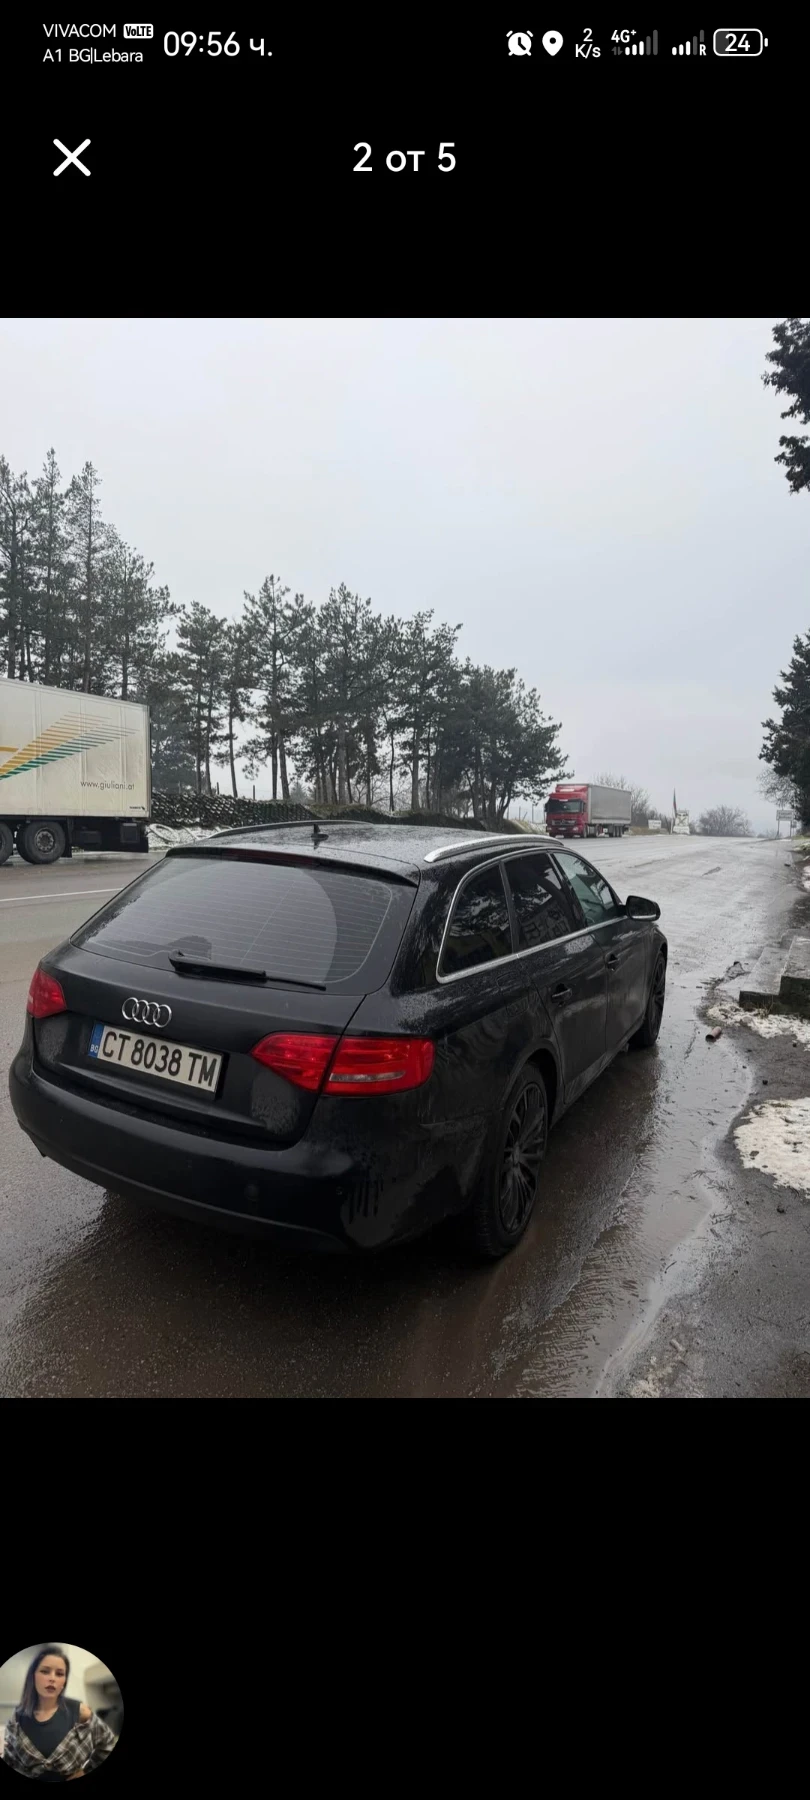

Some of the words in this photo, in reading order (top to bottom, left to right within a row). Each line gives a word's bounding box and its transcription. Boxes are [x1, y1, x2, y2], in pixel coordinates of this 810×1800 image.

[80, 780, 135, 791] www.giuliani.at
[90, 1044, 99, 1053] BG
[102, 1031, 131, 1061] CT
[130, 1039, 182, 1076] 8038
[188, 1051, 217, 1087] TM
